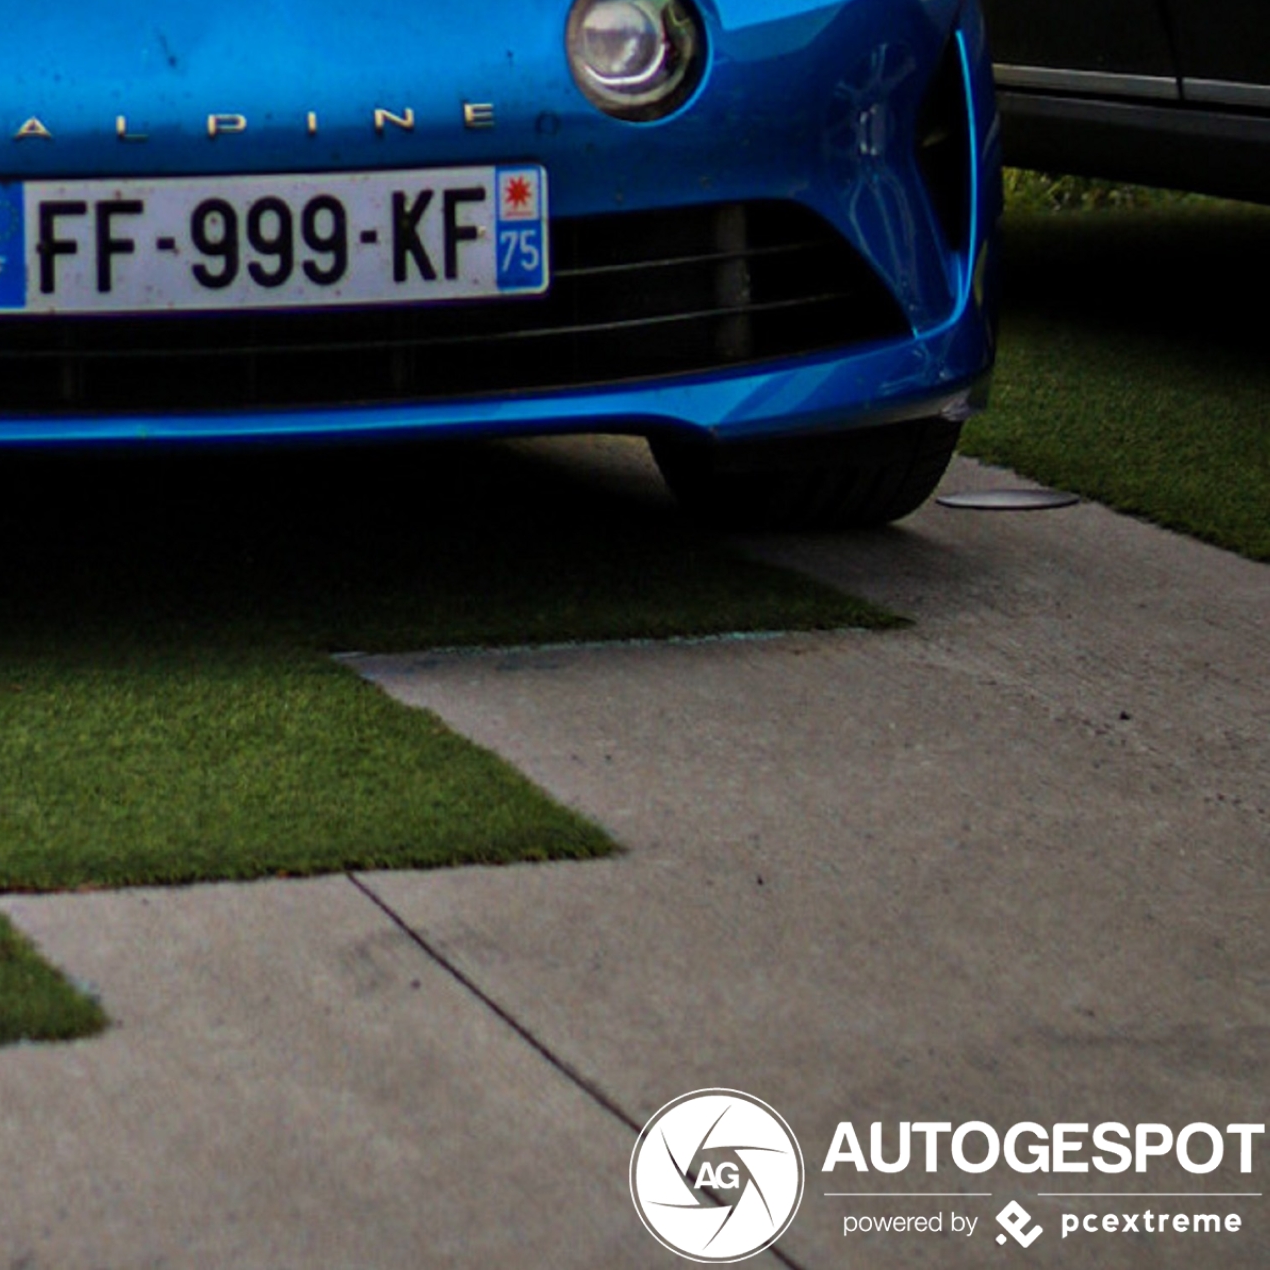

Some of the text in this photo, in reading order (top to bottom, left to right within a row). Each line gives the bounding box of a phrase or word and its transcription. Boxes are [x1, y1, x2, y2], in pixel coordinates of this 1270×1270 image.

[15, 103, 494, 140] ALPINE
[37, 186, 487, 294] FF-999-KF
[499, 228, 539, 272] 75
